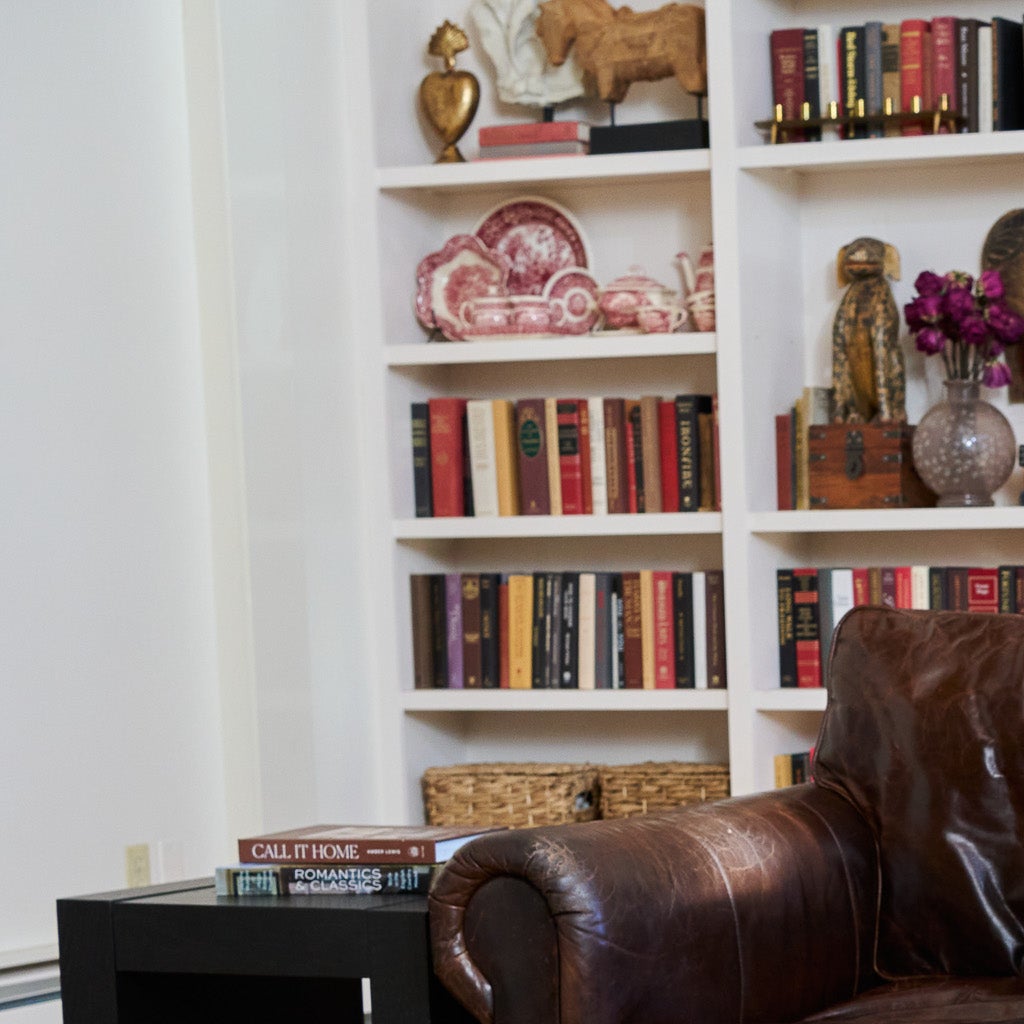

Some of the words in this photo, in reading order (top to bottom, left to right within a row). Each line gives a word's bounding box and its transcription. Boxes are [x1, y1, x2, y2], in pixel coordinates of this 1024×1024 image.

[251, 843, 291, 860] CALL
[294, 843, 308, 859] IT
[311, 843, 360, 860] HOME
[294, 868, 382, 880] ROMANTICS
[295, 880, 306, 891] &
[309, 879, 383, 891] CLASSICS
